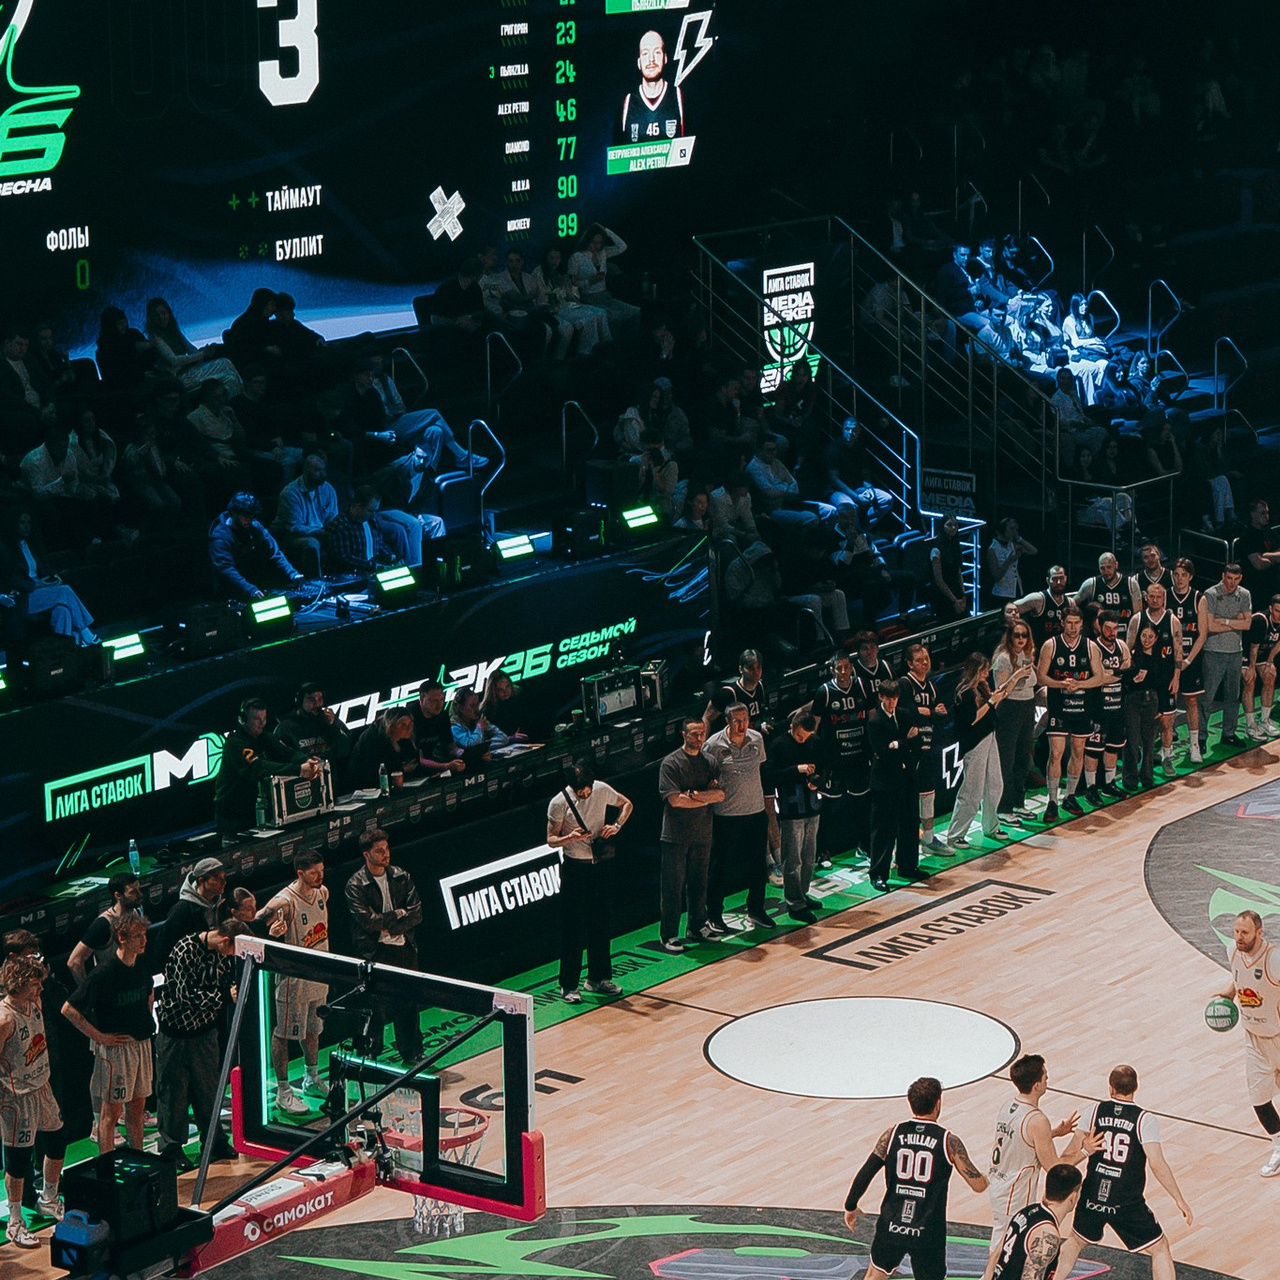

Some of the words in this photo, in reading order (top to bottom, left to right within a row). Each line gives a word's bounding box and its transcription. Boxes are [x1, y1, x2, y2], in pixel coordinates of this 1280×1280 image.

[555, 20, 577, 46] 23
[488, 65, 496, 79] 3
[555, 59, 577, 85] 24
[555, 98, 577, 123] 46
[646, 122, 660, 137] 46
[557, 136, 578, 161] 77
[629, 159, 646, 173] ALEX
[265, 185, 322, 212] ТАЙМАУТ
[557, 174, 578, 199] 90
[557, 212, 579, 238] 99
[46, 226, 90, 252] ФОЛЫ
[275, 235, 324, 261] БУЛЛИТ
[76, 259, 90, 290] 0
[764, 291, 815, 314] MEDIA
[764, 305, 815, 326] BASKET
[1105, 592, 1121, 605] 99
[559, 617, 637, 652] СЕДЬМОЙ
[556, 642, 610, 669] СЕЗОН
[1069, 654, 1077, 668] 8
[842, 696, 855, 710] 10
[55, 787, 90, 820] ЛИГА
[91, 772, 145, 809] СТАВОК
[458, 884, 503, 927] ЛИГА
[500, 863, 562, 911] СТАВОК
[301, 912, 308, 926] 8
[853, 930, 942, 965] ЛИГА
[920, 889, 1042, 946] СТАВОК
[19, 1025, 30, 1042] 26
[113, 1087, 127, 1101] 30
[18, 1130, 31, 1144] 26
[895, 1147, 934, 1183] 00
[261, 1189, 336, 1234] самокат
[1086, 1198, 1117, 1215] loom
[888, 1221, 922, 1238] loom
